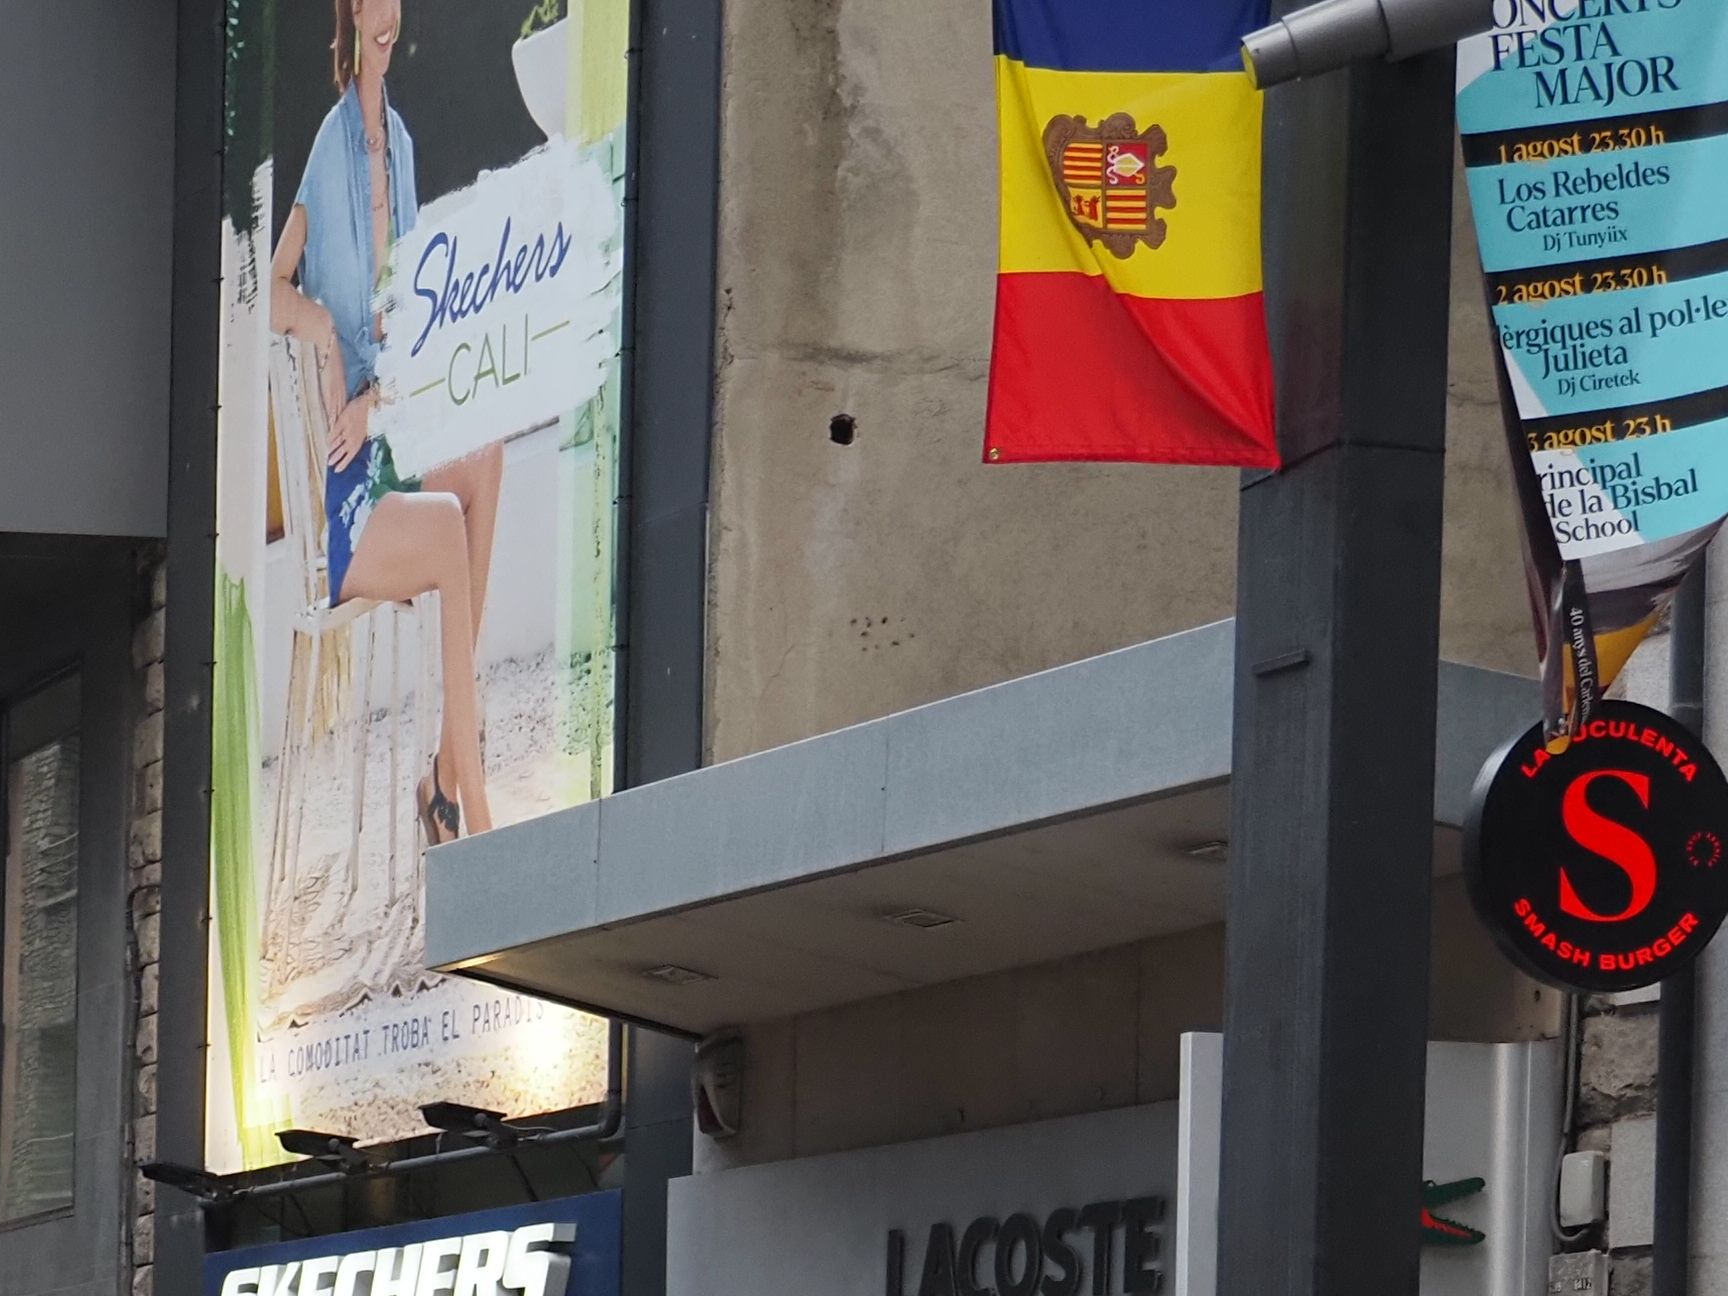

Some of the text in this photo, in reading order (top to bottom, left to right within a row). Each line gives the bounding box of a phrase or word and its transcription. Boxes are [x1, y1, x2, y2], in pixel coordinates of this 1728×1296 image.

[1488, 21, 1623, 72] FESTA
[1535, 55, 1681, 109] MAJOR
[1497, 145, 1507, 166] 1
[1512, 131, 1584, 167] agost
[1650, 126, 1665, 146] h
[1498, 162, 1671, 205] Los Rebeldes
[1506, 201, 1620, 233] Catarres
[1544, 234, 1561, 253] Dj
[410, 216, 572, 357] Skechers
[1496, 286, 1509, 305] 2
[1513, 272, 1585, 304] agost
[1652, 265, 1668, 285] h
[1619, 307, 1643, 335] al
[447, 313, 531, 407] CALI
[1542, 343, 1628, 380] Julieta
[1557, 369, 1641, 398] Dj Ciretek
[1527, 414, 1672, 453] 3 agost 23 h
[1579, 489, 1604, 516] la
[1609, 468, 1699, 510] Bisbal
[1553, 511, 1641, 544] School
[1559, 768, 1657, 922] S
[1513, 897, 1700, 971] SMASH BURGER
[441, 1009, 461, 1042] EL
